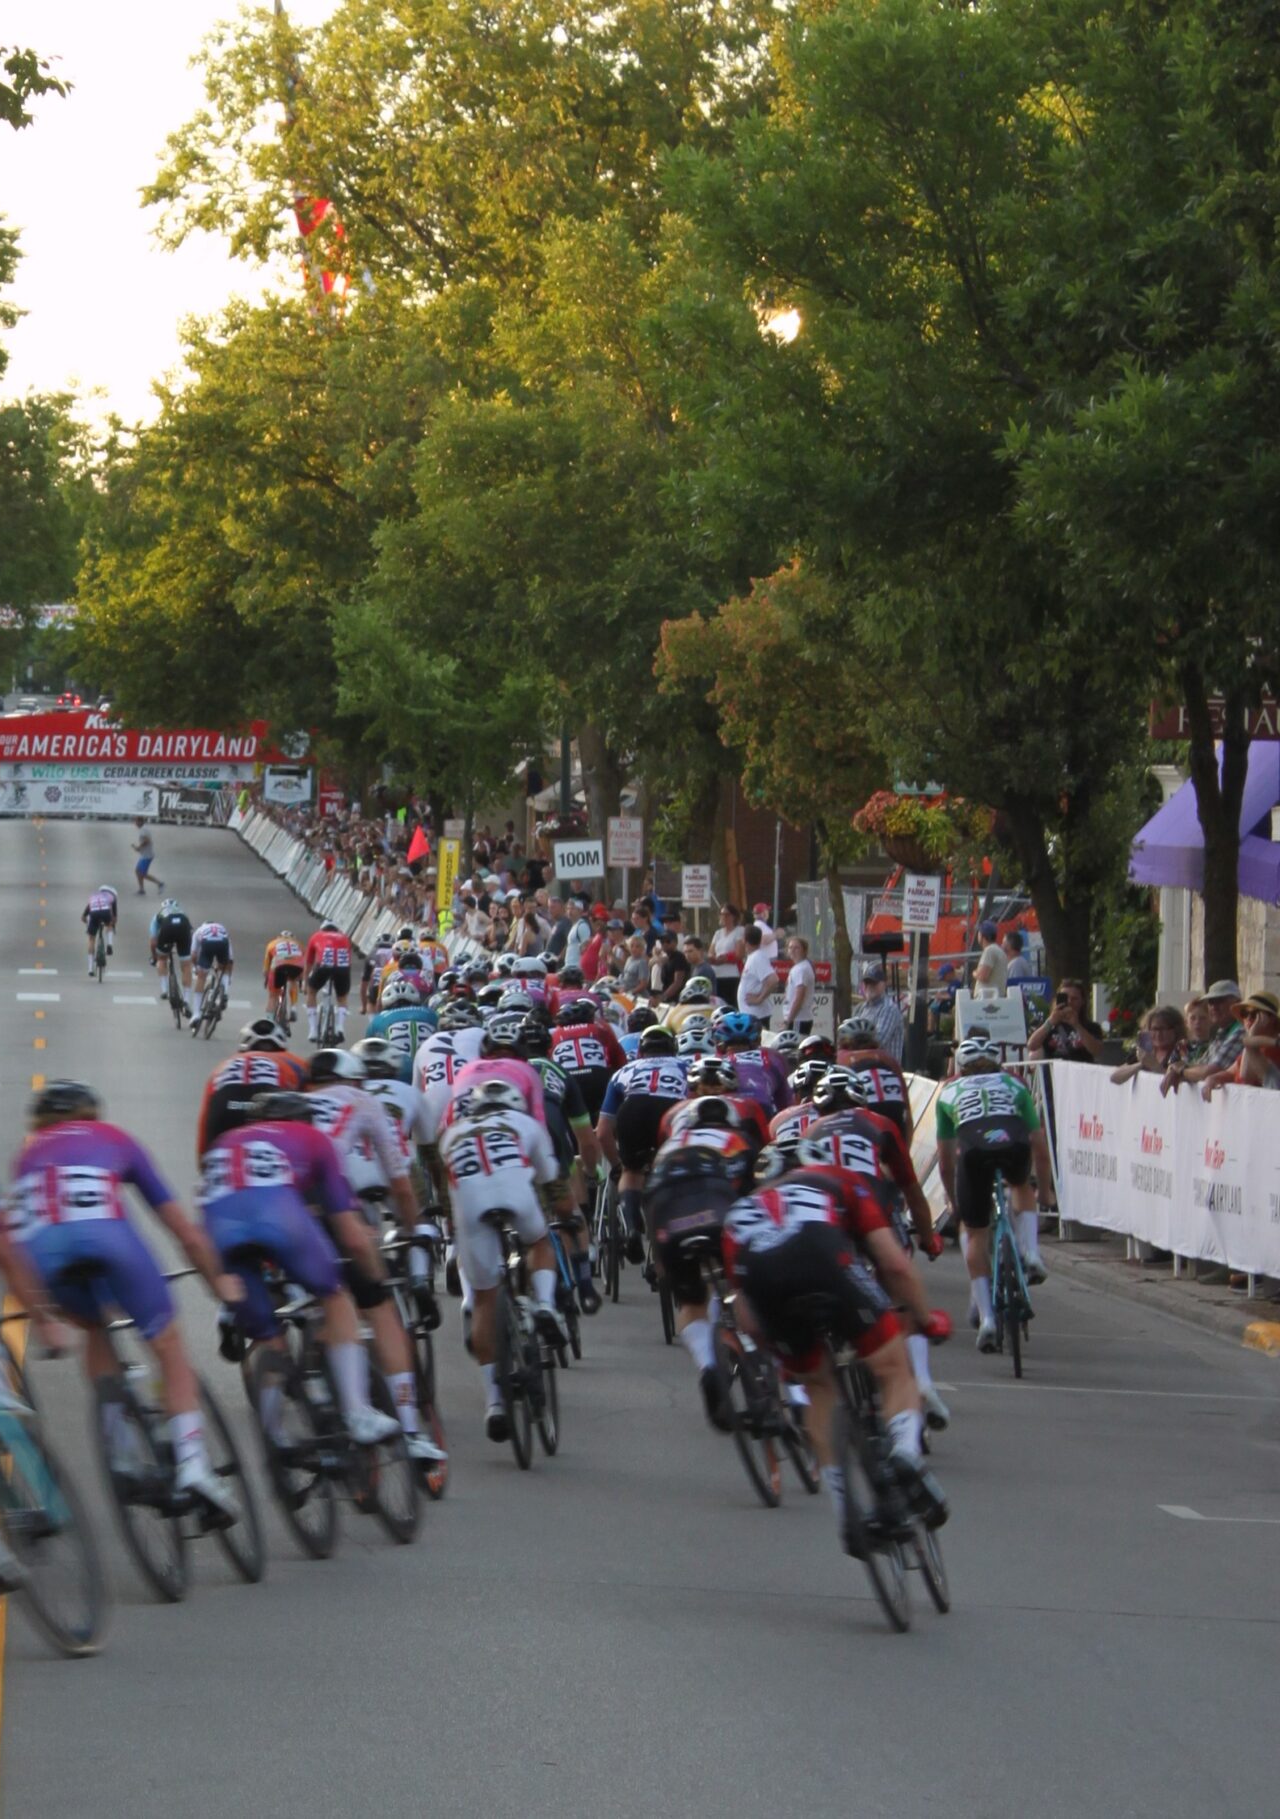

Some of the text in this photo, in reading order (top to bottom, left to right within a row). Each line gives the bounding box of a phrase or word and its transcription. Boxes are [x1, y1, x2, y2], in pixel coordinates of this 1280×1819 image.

[4, 745, 16, 757] OF
[16, 735, 257, 757] AMERICA'S DAIRYLAND
[103, 766, 139, 779] CEDAR
[140, 766, 174, 779] CREEK
[174, 767, 220, 779] CLASSIC
[558, 850, 600, 868] 100M
[907, 887, 936, 897] PARKING
[916, 879, 927, 887] NO
[554, 1044, 576, 1064] 34
[581, 1042, 604, 1061] 34
[425, 1061, 447, 1085] 62
[450, 1140, 480, 1177] 119
[486, 1132, 522, 1166] 119
[842, 1140, 876, 1168] 74
